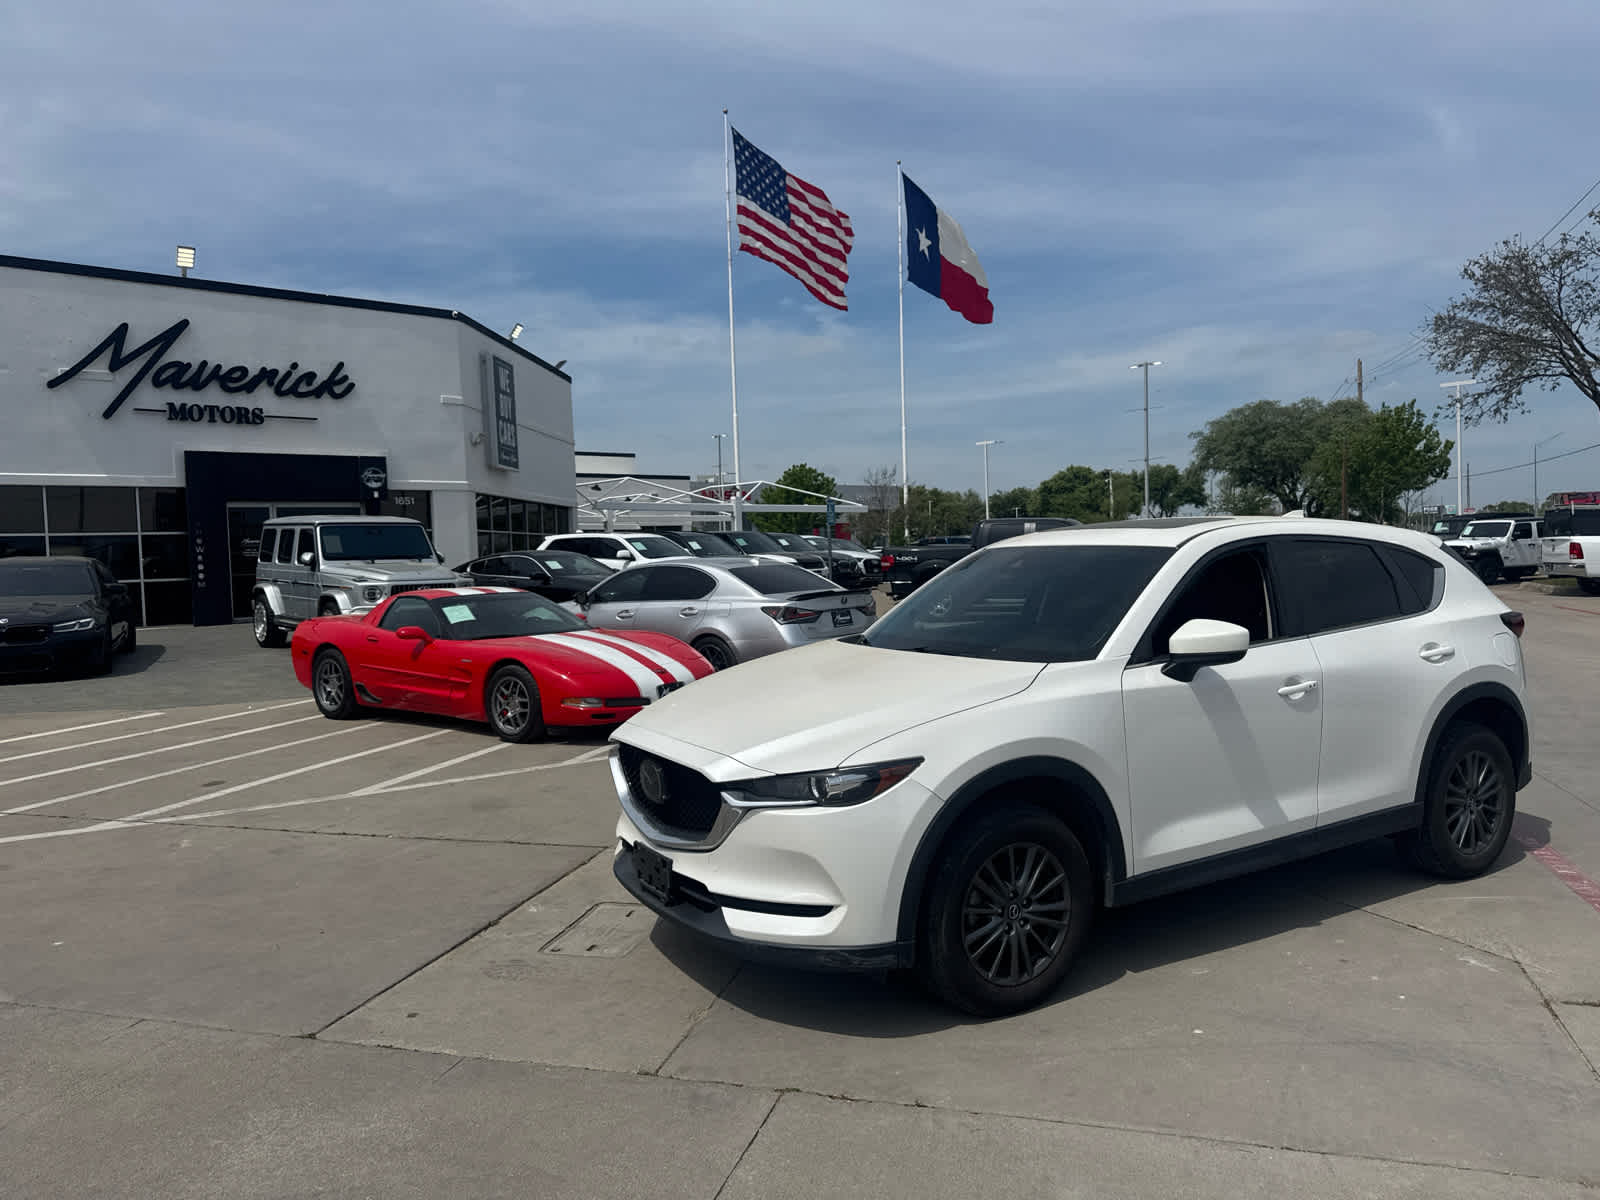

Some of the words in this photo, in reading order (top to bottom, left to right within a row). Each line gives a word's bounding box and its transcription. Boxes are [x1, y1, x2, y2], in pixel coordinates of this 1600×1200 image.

[47, 319, 356, 419] Maverick
[499, 366, 511, 393] WE
[166, 402, 265, 425] MOTORS
[500, 419, 516, 447] CARS
[700, 489, 752, 501] NISN
